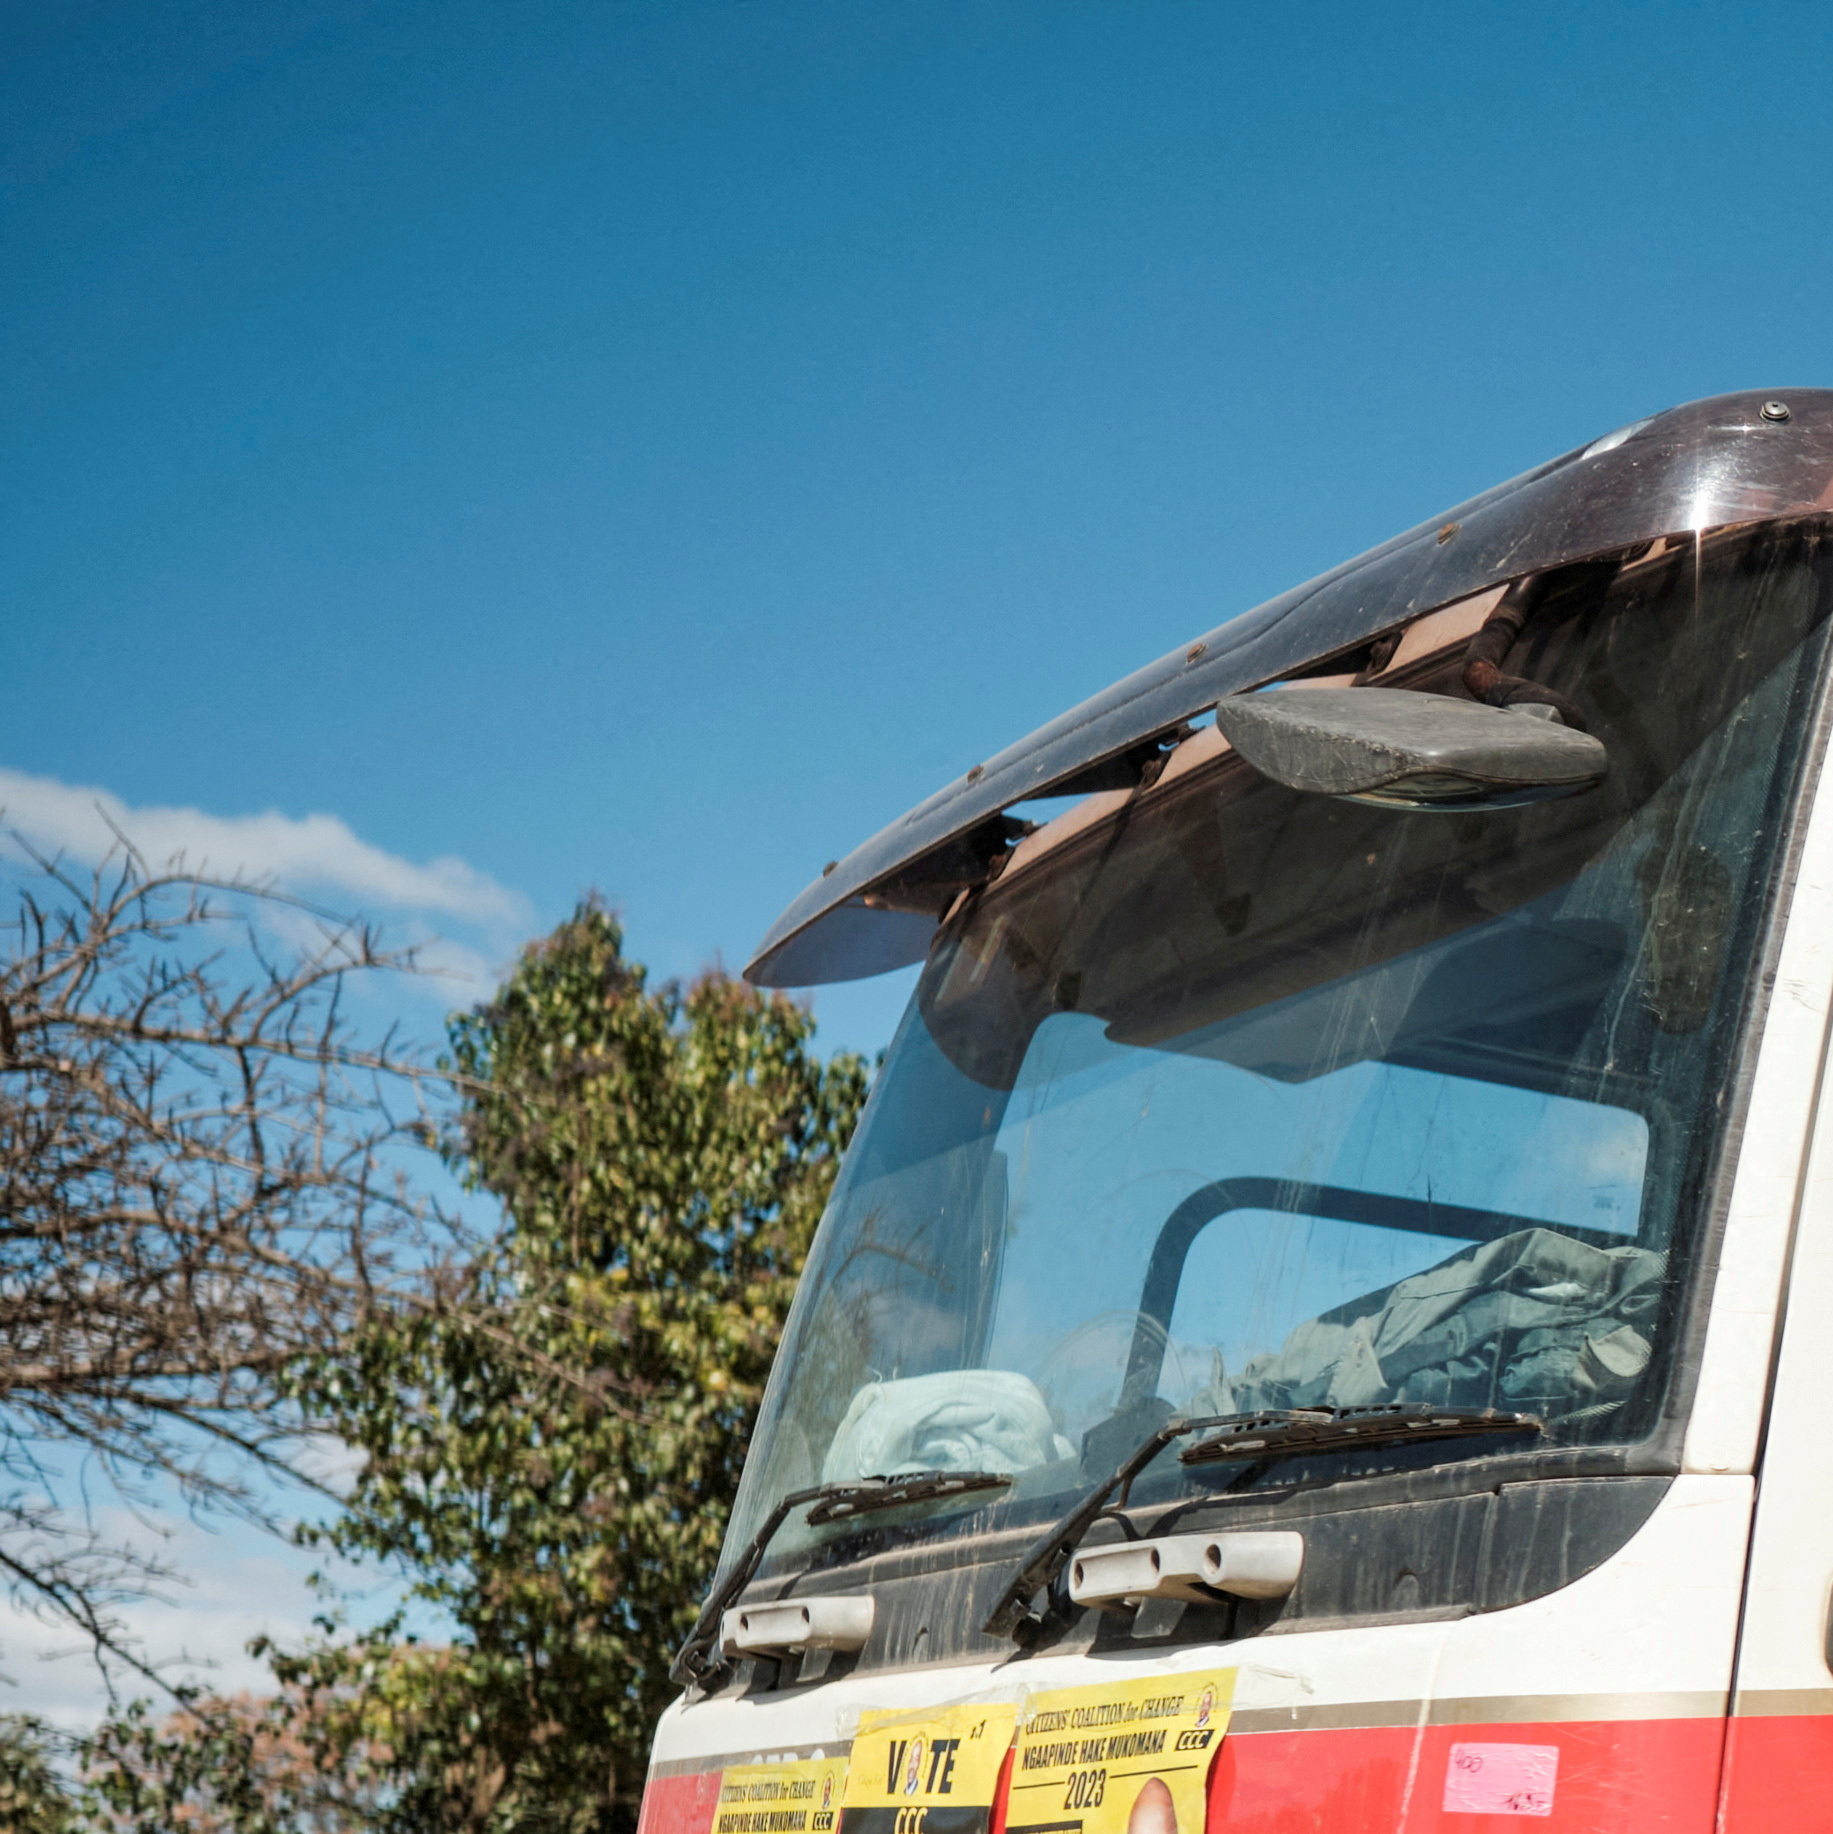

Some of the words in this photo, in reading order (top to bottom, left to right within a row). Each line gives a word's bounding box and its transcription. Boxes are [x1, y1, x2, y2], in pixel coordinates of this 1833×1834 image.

[1071, 1702, 1125, 1729] COALITION
[1140, 1695, 1185, 1719] CHANGE
[1022, 1741, 1078, 1771] NGAAPINDE
[1079, 1737, 1107, 1764] HAKE
[1106, 1729, 1167, 1760] MUKOMANA
[1178, 1731, 1209, 1750] CCC
[887, 1738, 960, 1795] VTE
[1063, 1768, 1107, 1811] 2023
